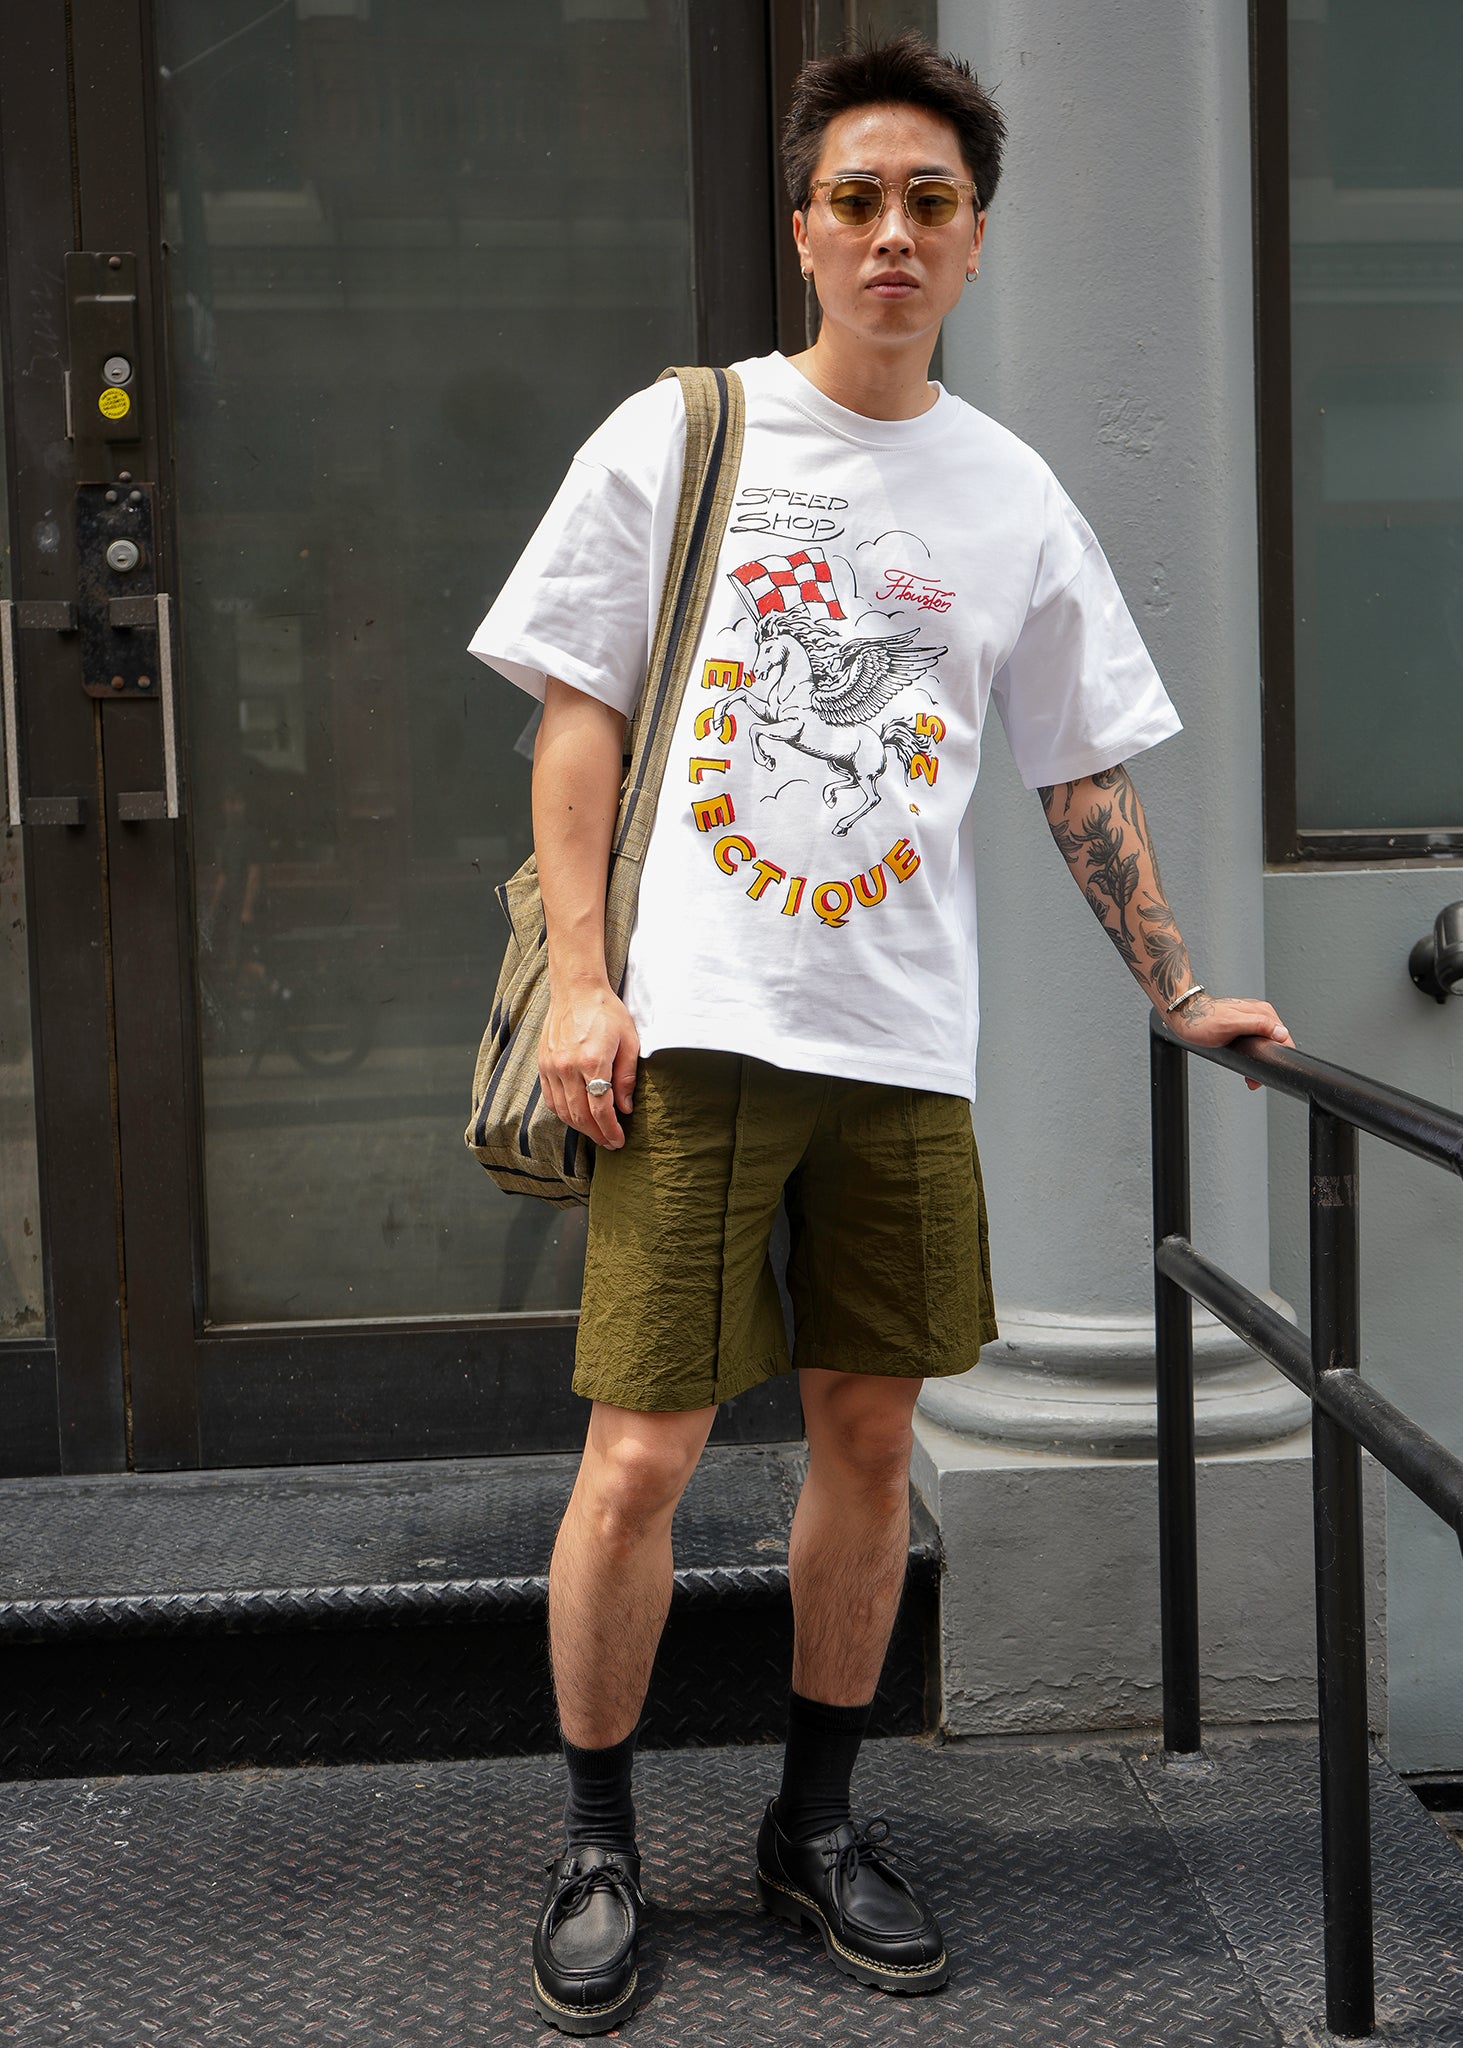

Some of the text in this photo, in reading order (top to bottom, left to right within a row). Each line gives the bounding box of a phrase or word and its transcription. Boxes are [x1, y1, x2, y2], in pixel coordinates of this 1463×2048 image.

[736, 487, 849, 511] SPEED
[730, 511, 846, 542] SHOP
[875, 569, 956, 613] Houston
